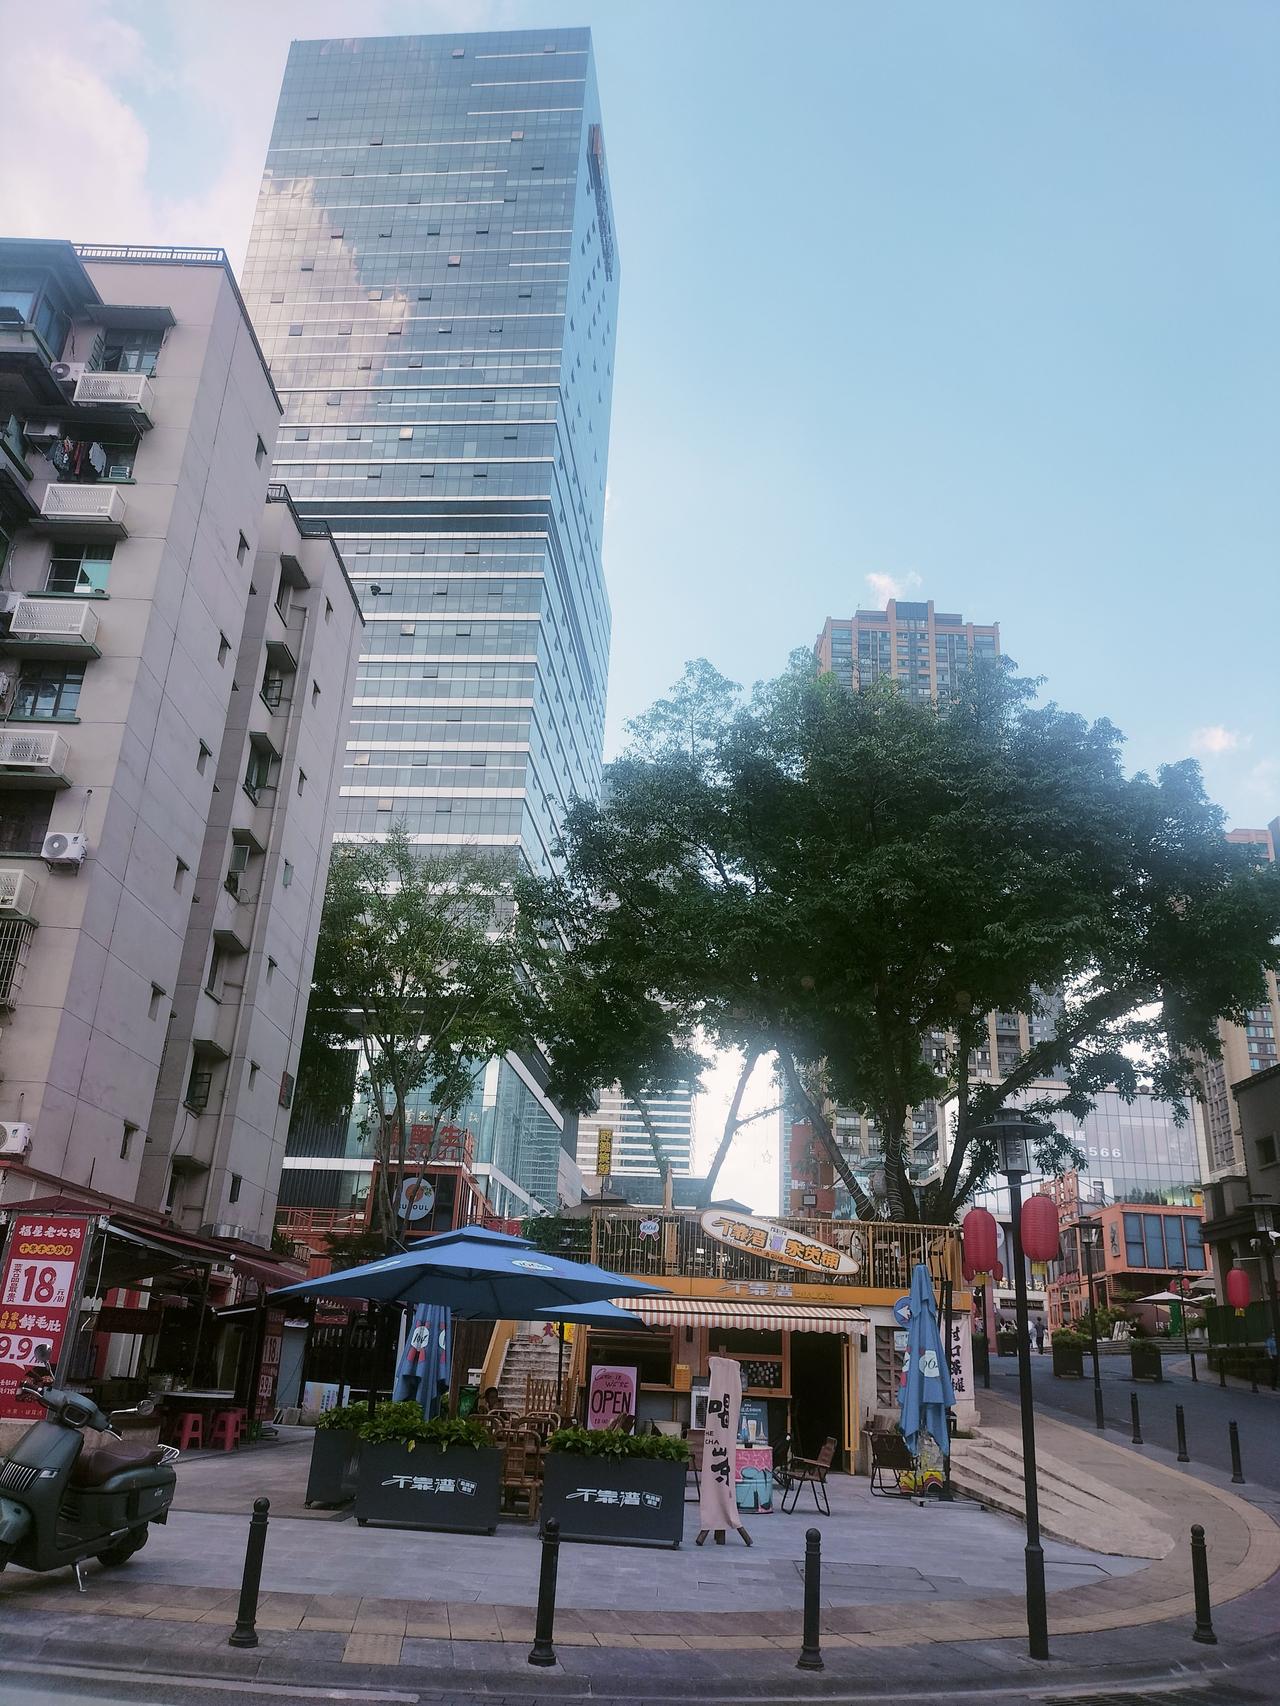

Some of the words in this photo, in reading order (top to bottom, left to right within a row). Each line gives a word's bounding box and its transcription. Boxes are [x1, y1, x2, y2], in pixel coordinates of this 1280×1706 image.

[400, 1203, 429, 1211] UOUL
[22, 1265, 57, 1303] 18
[591, 1389, 632, 1414] OPEN
